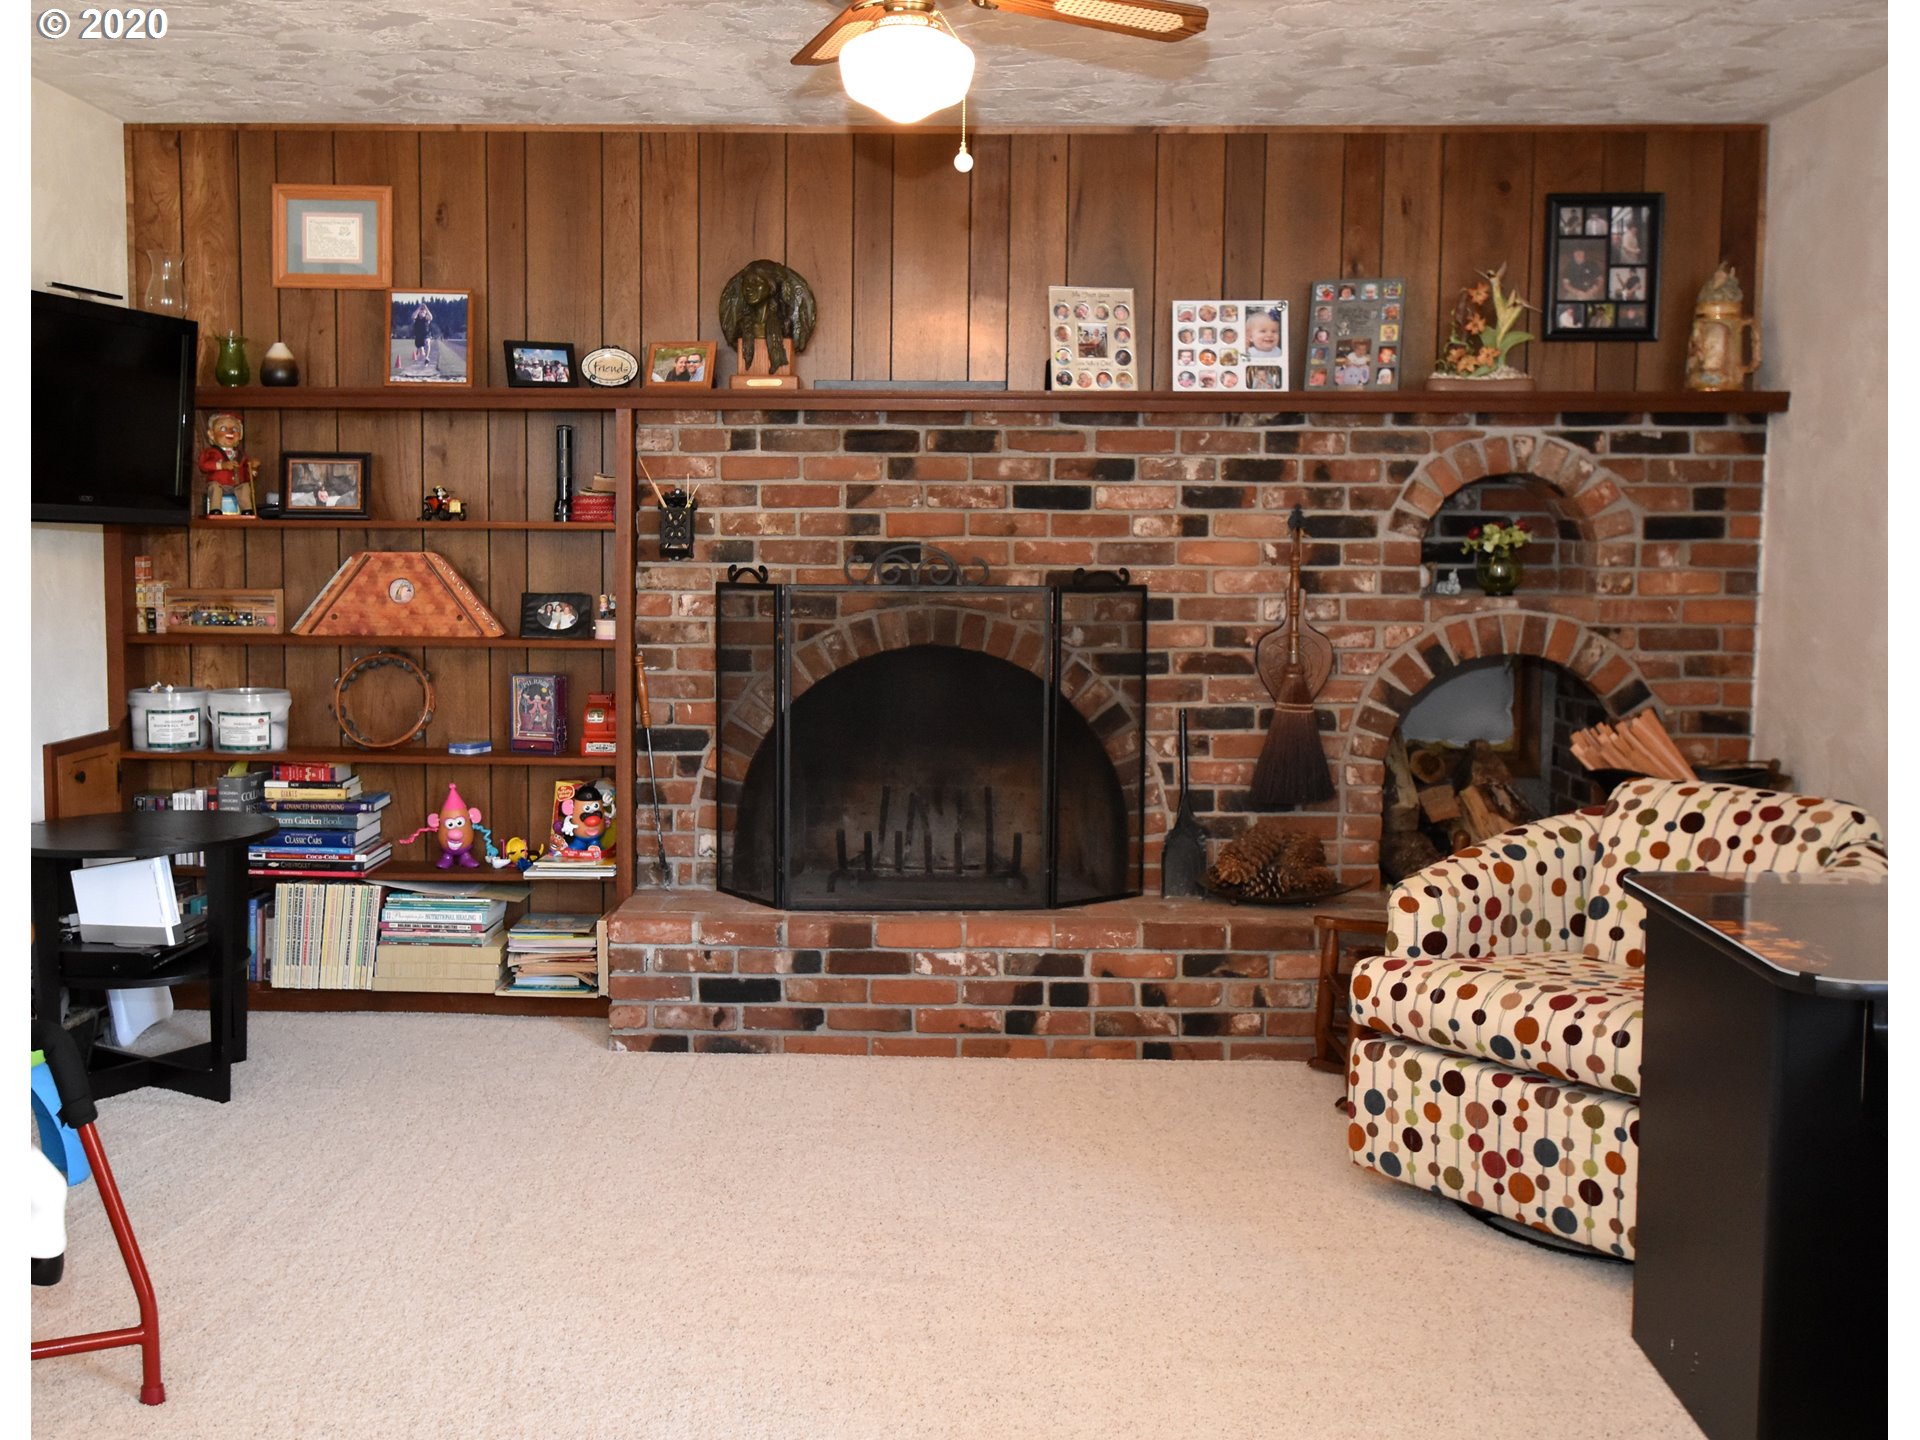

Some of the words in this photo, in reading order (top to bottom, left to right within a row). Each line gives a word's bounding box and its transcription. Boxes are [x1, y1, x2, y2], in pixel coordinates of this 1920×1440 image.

[294, 816, 322, 825] Garden
[323, 816, 343, 825] Book
[284, 835, 306, 844] CLASSIC
[308, 836, 322, 845] CARS
